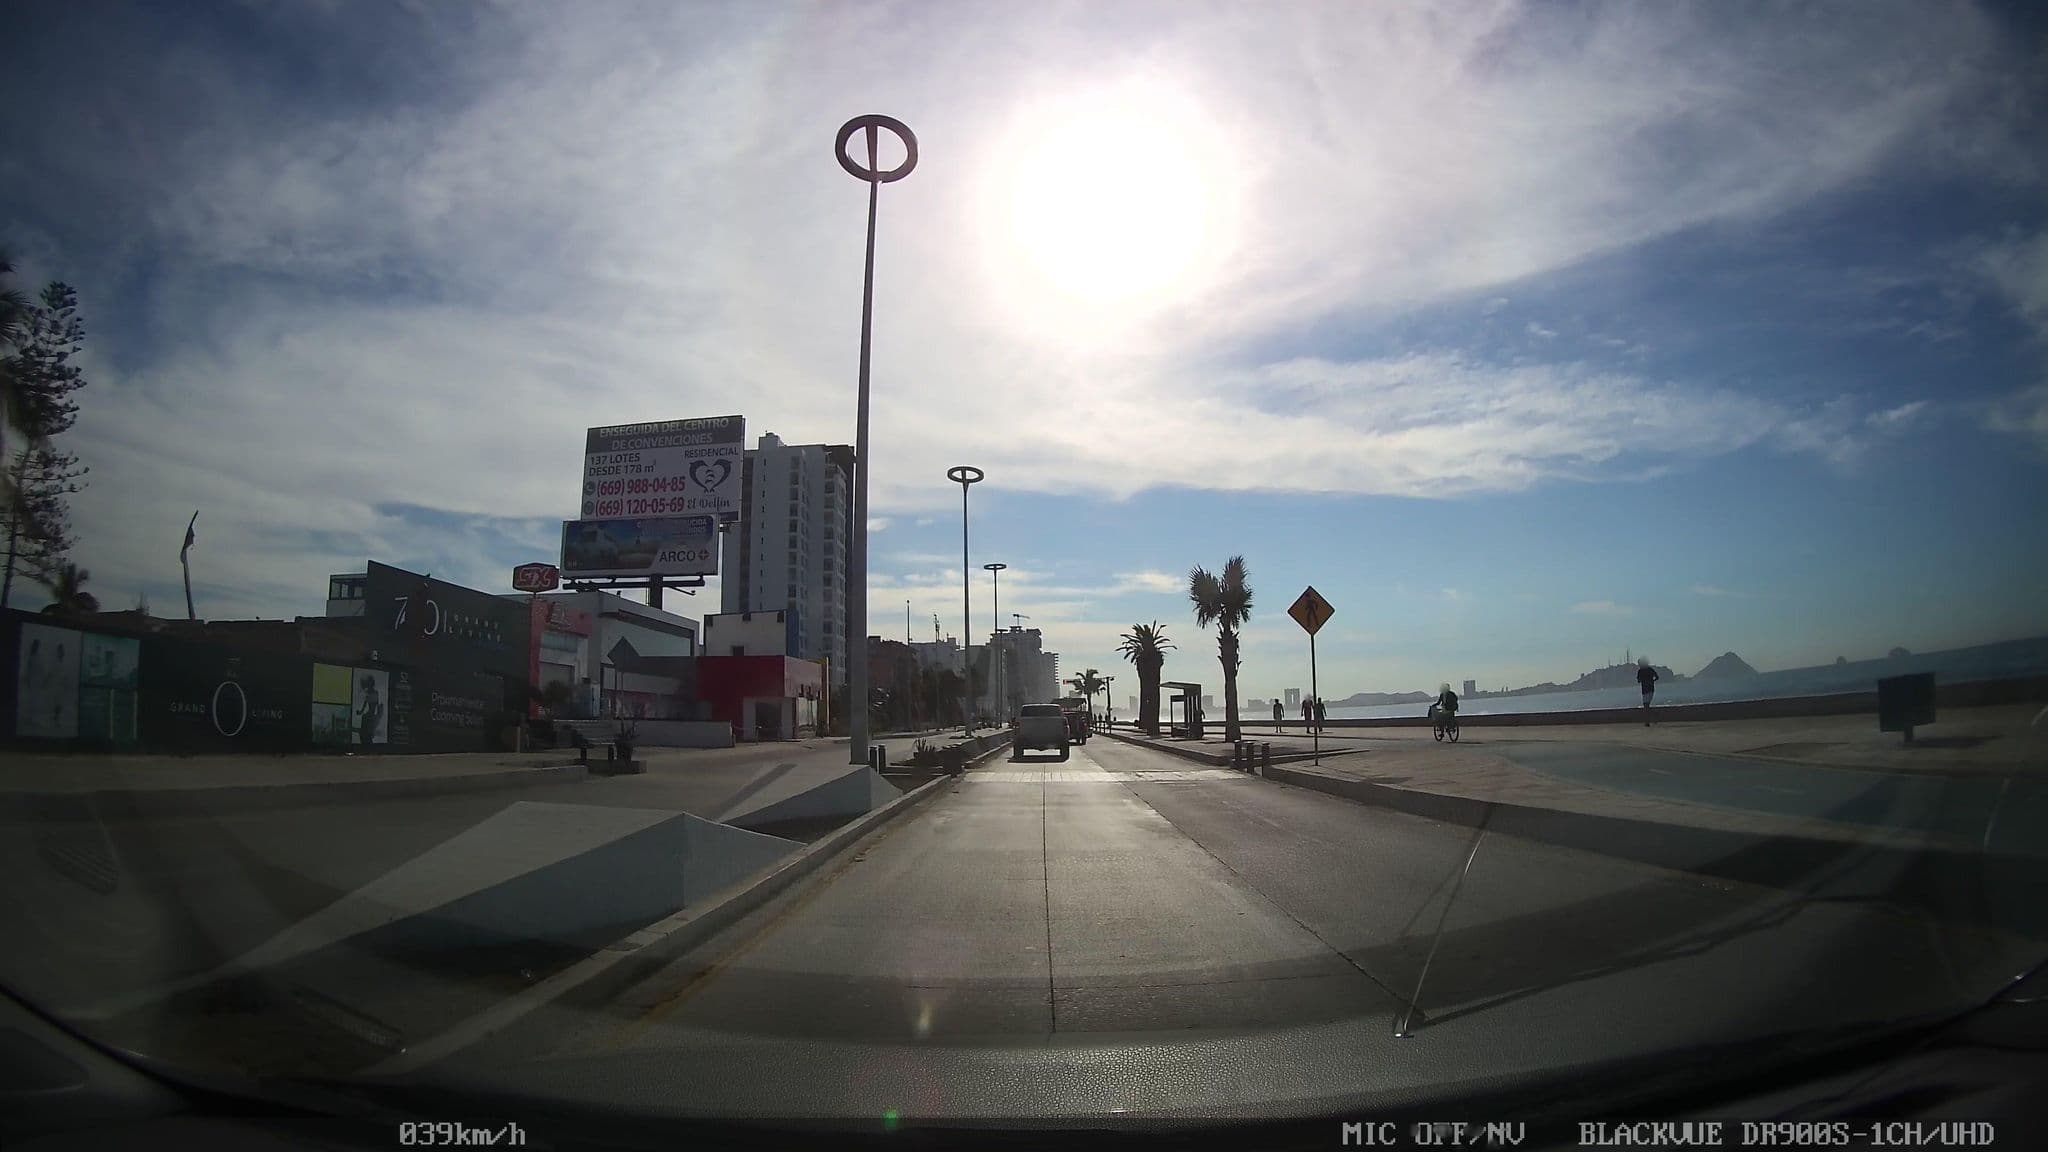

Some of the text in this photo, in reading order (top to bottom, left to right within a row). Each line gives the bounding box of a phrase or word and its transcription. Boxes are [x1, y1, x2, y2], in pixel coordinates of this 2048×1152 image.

[600, 418, 730, 438] ENSEGUIDA DEL CENTRO
[612, 433, 713, 451] DE CONVENCIONES
[590, 453, 641, 466] 137 LOTES
[684, 446, 739, 459] RESIDENCIAL
[589, 465, 621, 477] DESDE
[625, 463, 642, 475] 178
[597, 476, 687, 498] (669) 988-04-85
[595, 497, 686, 517] (669) 120-05-69
[659, 550, 697, 563] ARCO
[251, 707, 285, 721] LVING
